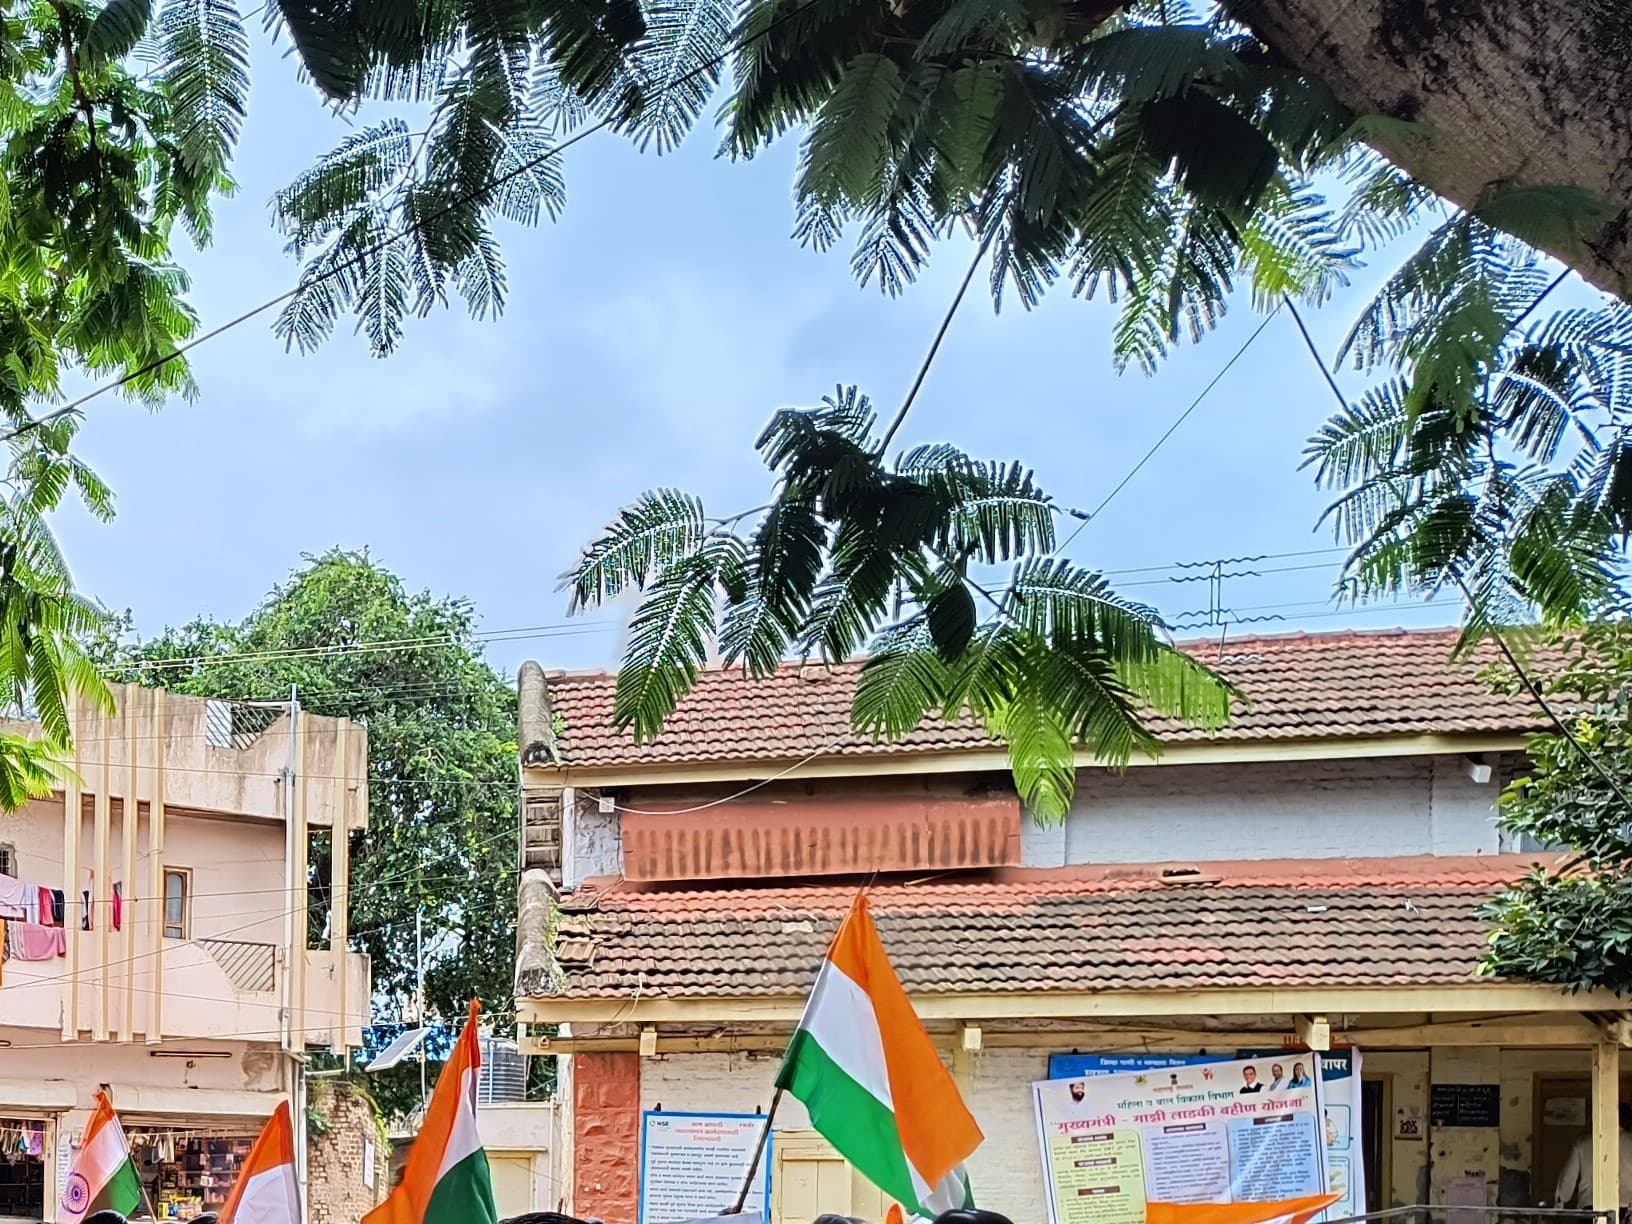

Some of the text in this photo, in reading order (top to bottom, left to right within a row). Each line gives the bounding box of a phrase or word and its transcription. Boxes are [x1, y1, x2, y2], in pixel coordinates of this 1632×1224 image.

[1176, 1093, 1206, 1104] विकास
[1208, 1090, 1234, 1101] विभाग
[1171, 1104, 1215, 1120] लाडकी
[1220, 1101, 1257, 1116] बहीण
